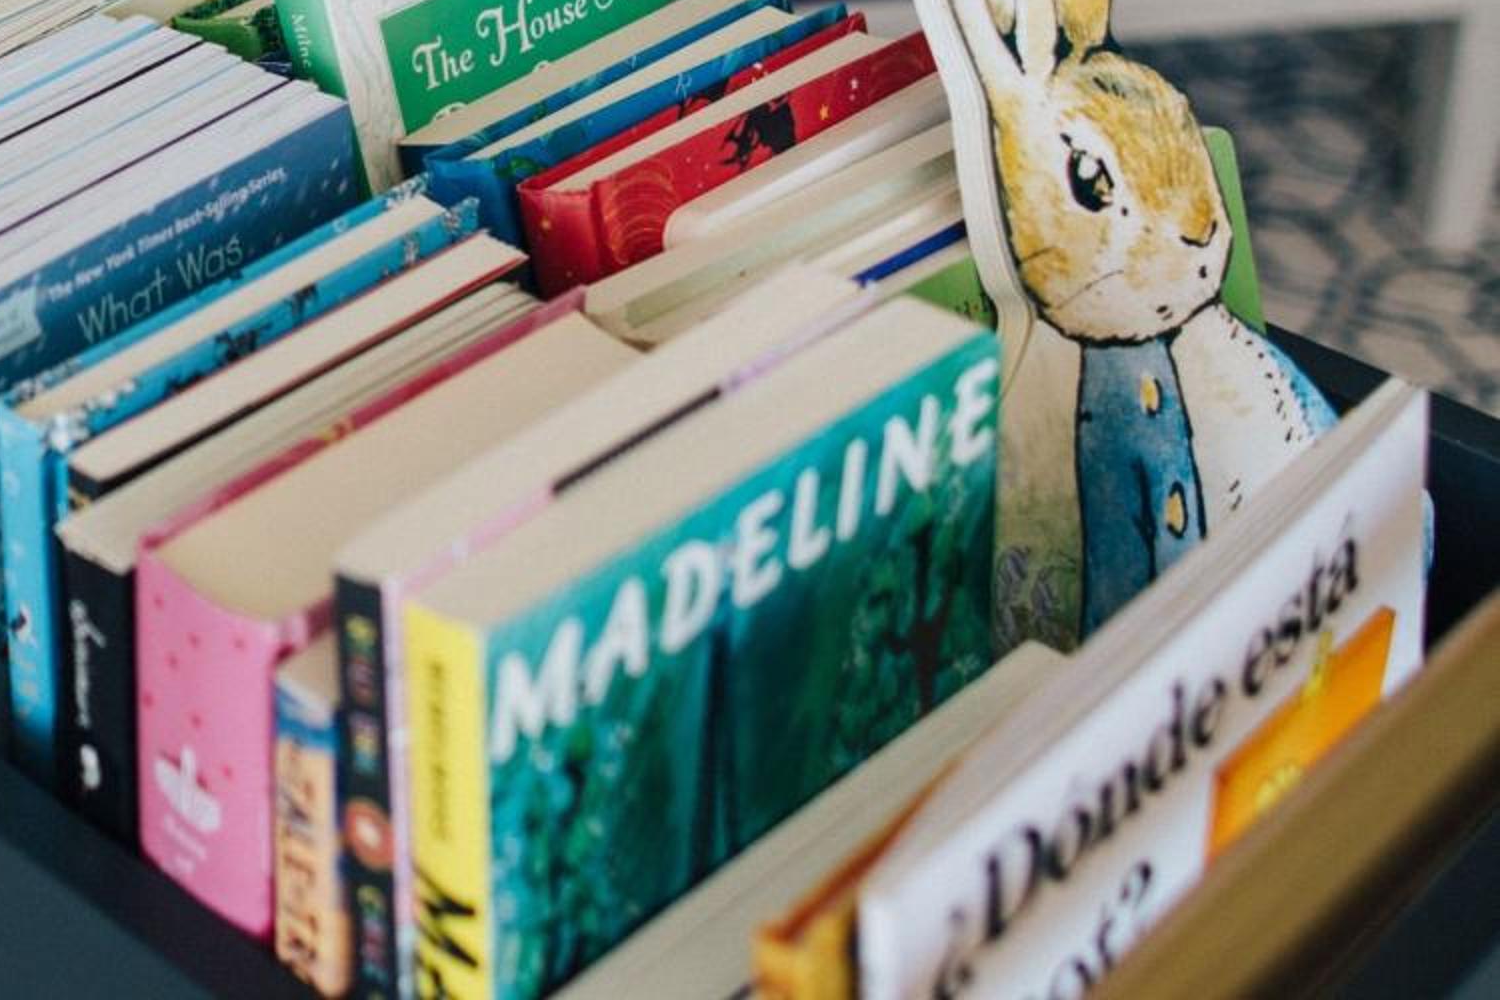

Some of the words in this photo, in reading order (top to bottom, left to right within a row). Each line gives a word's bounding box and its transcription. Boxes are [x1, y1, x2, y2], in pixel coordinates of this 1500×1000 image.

[412, 35, 476, 92] The
[48, 280, 73, 302] The
[73, 263, 105, 288] New
[105, 245, 136, 272] York
[76, 266, 168, 346] What
[174, 232, 244, 292] Was
[488, 357, 1000, 765] MADELINE
